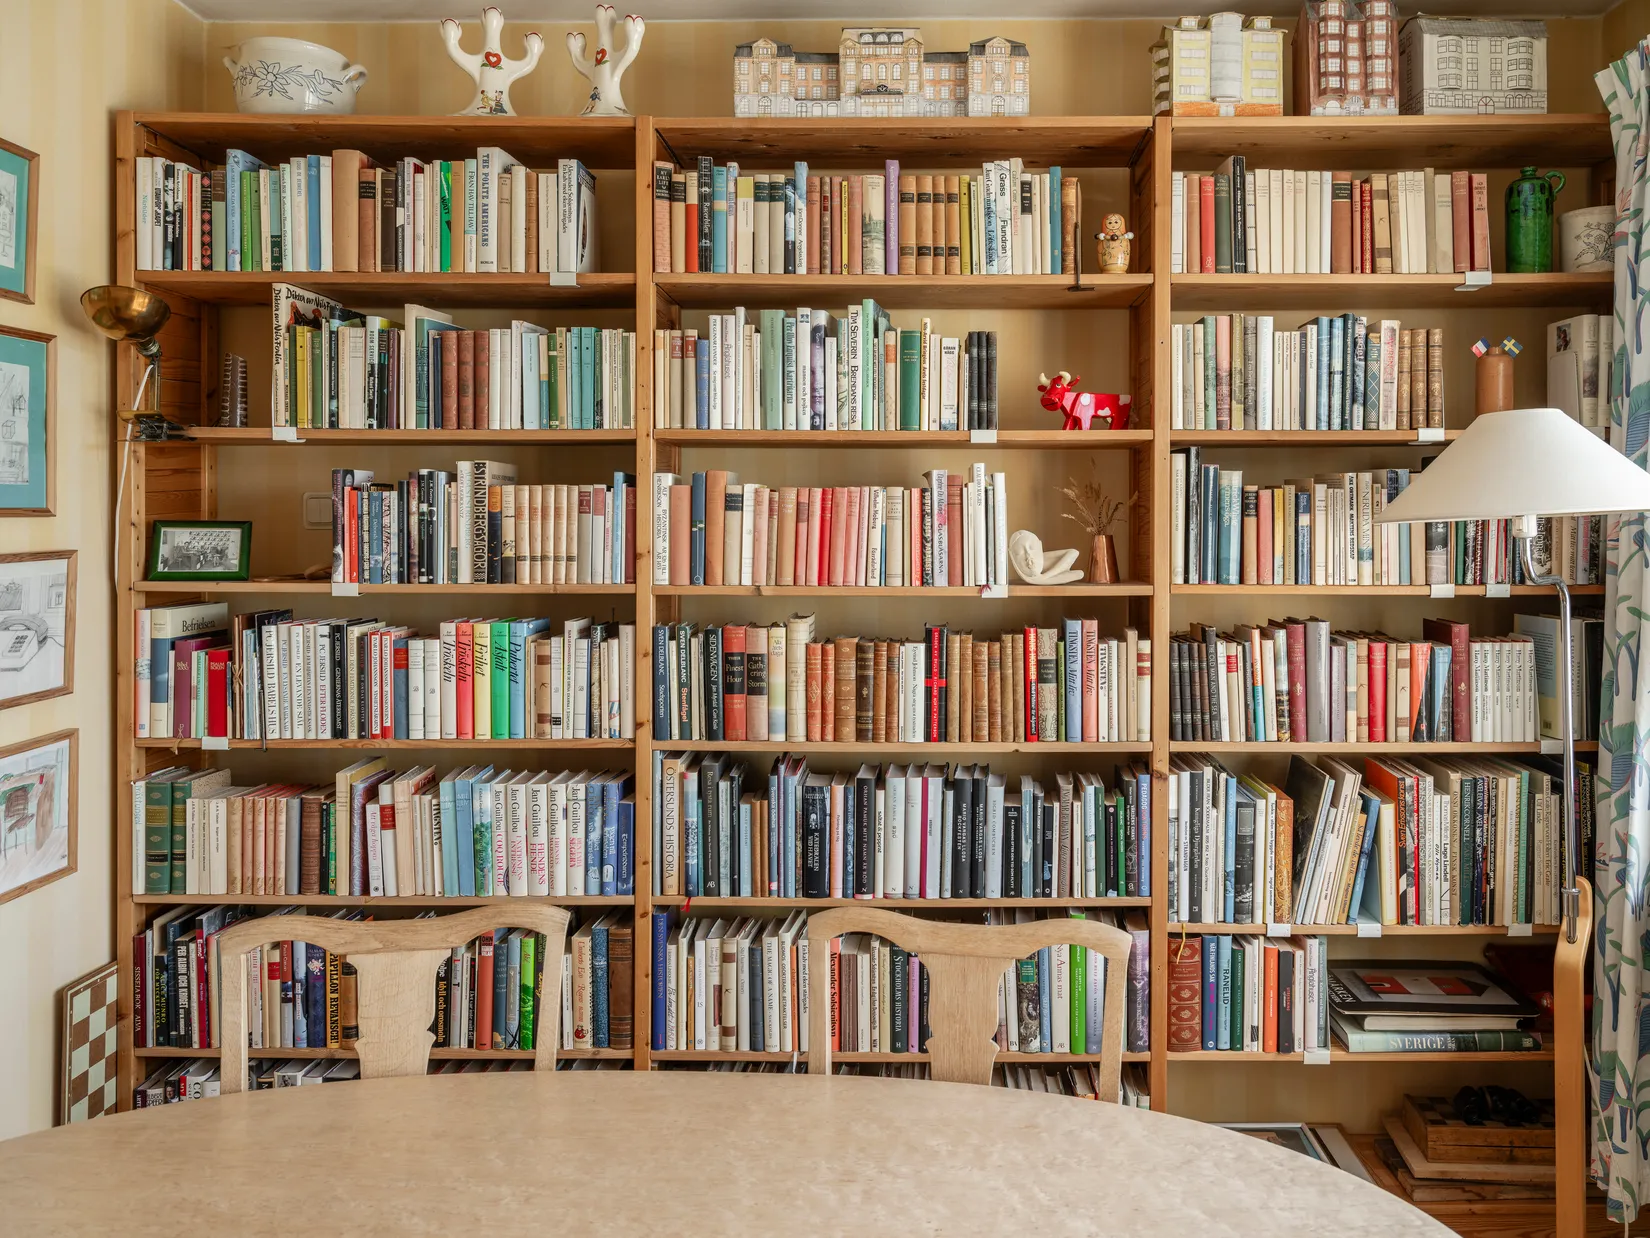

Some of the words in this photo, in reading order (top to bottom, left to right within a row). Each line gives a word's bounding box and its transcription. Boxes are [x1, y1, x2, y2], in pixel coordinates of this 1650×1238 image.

[441, 196, 449, 214] WATT
[273, 288, 282, 311] Dikter
[474, 468, 486, 534] STRINDBERG
[474, 534, 486, 568] SAGOR
[182, 617, 216, 632] Befrielsen
[266, 630, 274, 642] PC
[266, 644, 274, 679] JERSILD
[442, 640, 455, 682] Tröskeln
[458, 640, 471, 682] Tröskeln
[475, 642, 488, 676] Frihet
[492, 642, 507, 672] Asfalt
[510, 642, 521, 684] Pubertet
[1069, 631, 1078, 664] TINGSTEN
[1069, 667, 1077, 684] Mitt
[532, 788, 540, 802] Jan
[666, 767, 676, 830] ÖSTERSUNDS
[532, 804, 541, 837] Guillou
[495, 834, 503, 853] COQ
[666, 834, 674, 878] HISTORIA
[178, 946, 186, 956] PER
[178, 958, 187, 973] ALBIN
[179, 975, 187, 987] OCH
[330, 954, 339, 994] PAPILLON
[768, 978, 773, 986] OF
[893, 956, 903, 1000] STOCKHOLMS
[179, 988, 188, 1008] KRIGET
[330, 997, 338, 1043] REVANSCH!
[1389, 1036, 1447, 1050] SVERIGE
